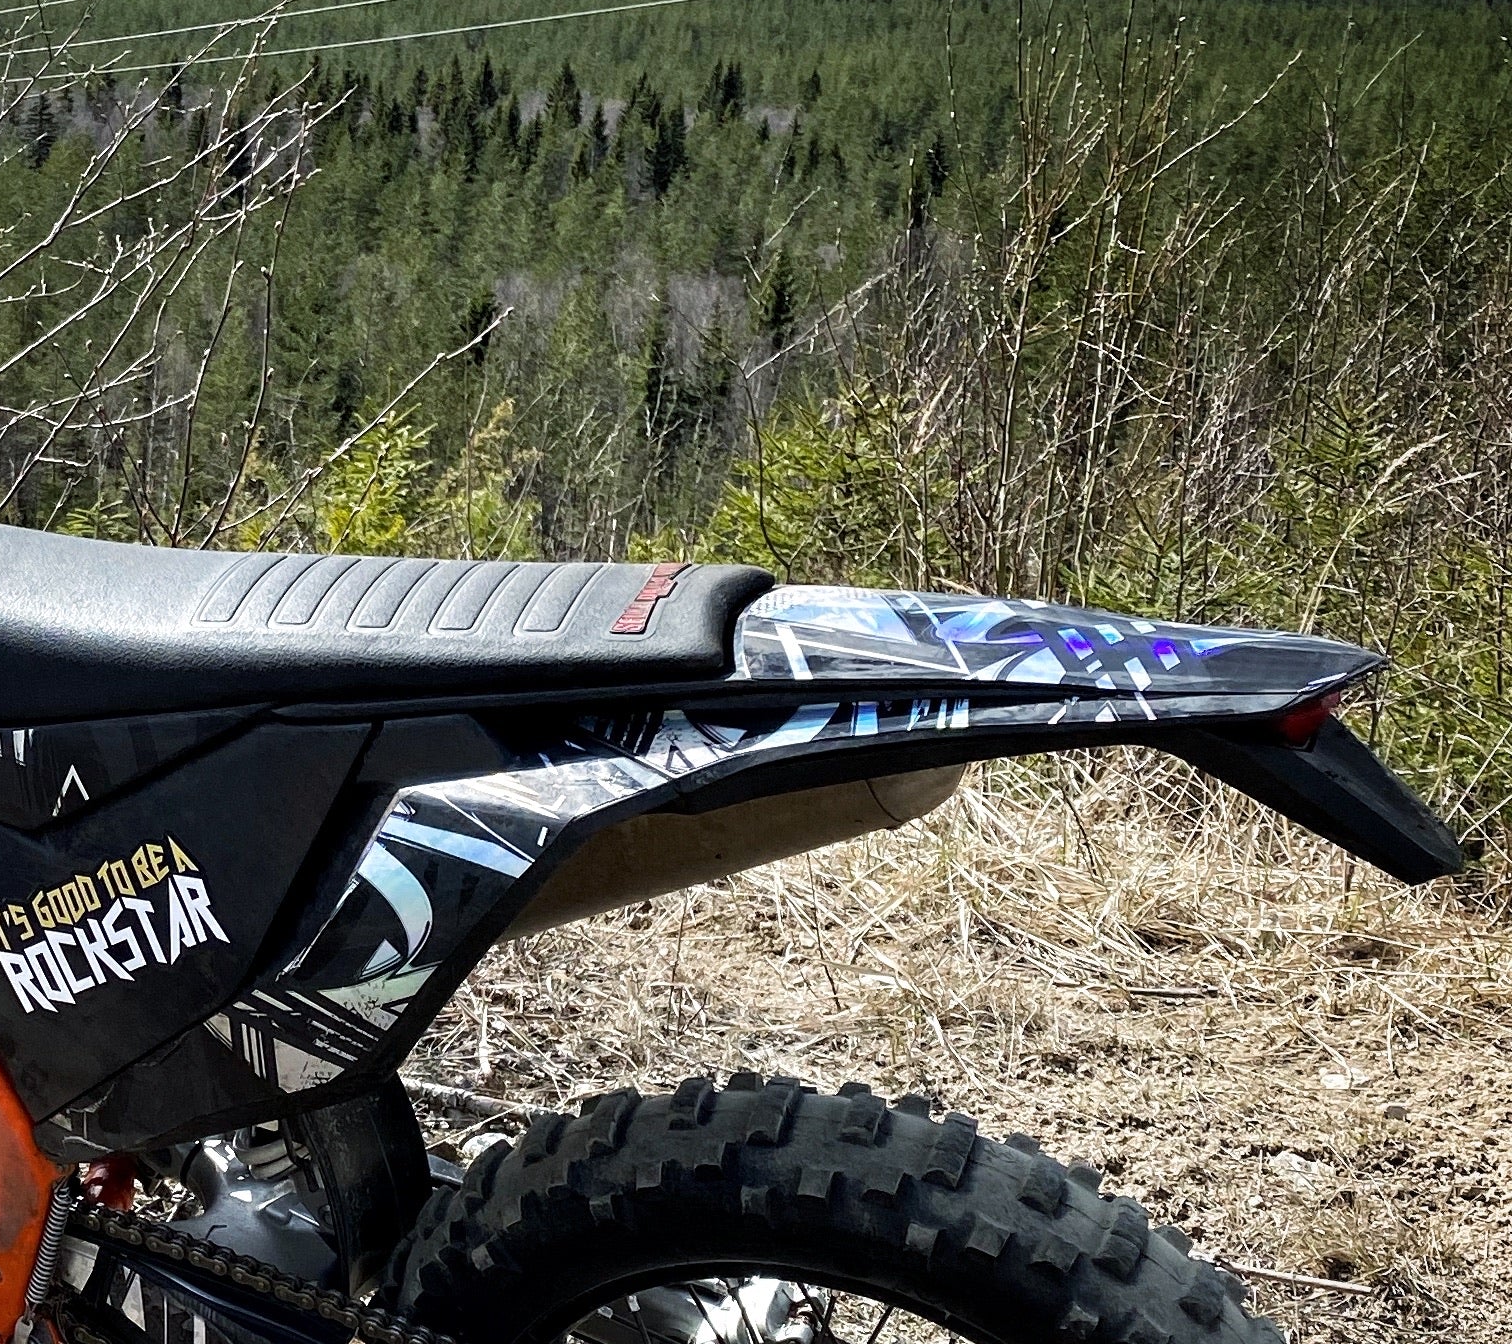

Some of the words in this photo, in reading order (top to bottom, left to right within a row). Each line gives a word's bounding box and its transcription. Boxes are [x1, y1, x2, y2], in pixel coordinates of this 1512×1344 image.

[32, 874, 102, 929] GOOD
[96, 859, 137, 900] TO
[131, 843, 170, 889] BE
[167, 834, 200, 873] A
